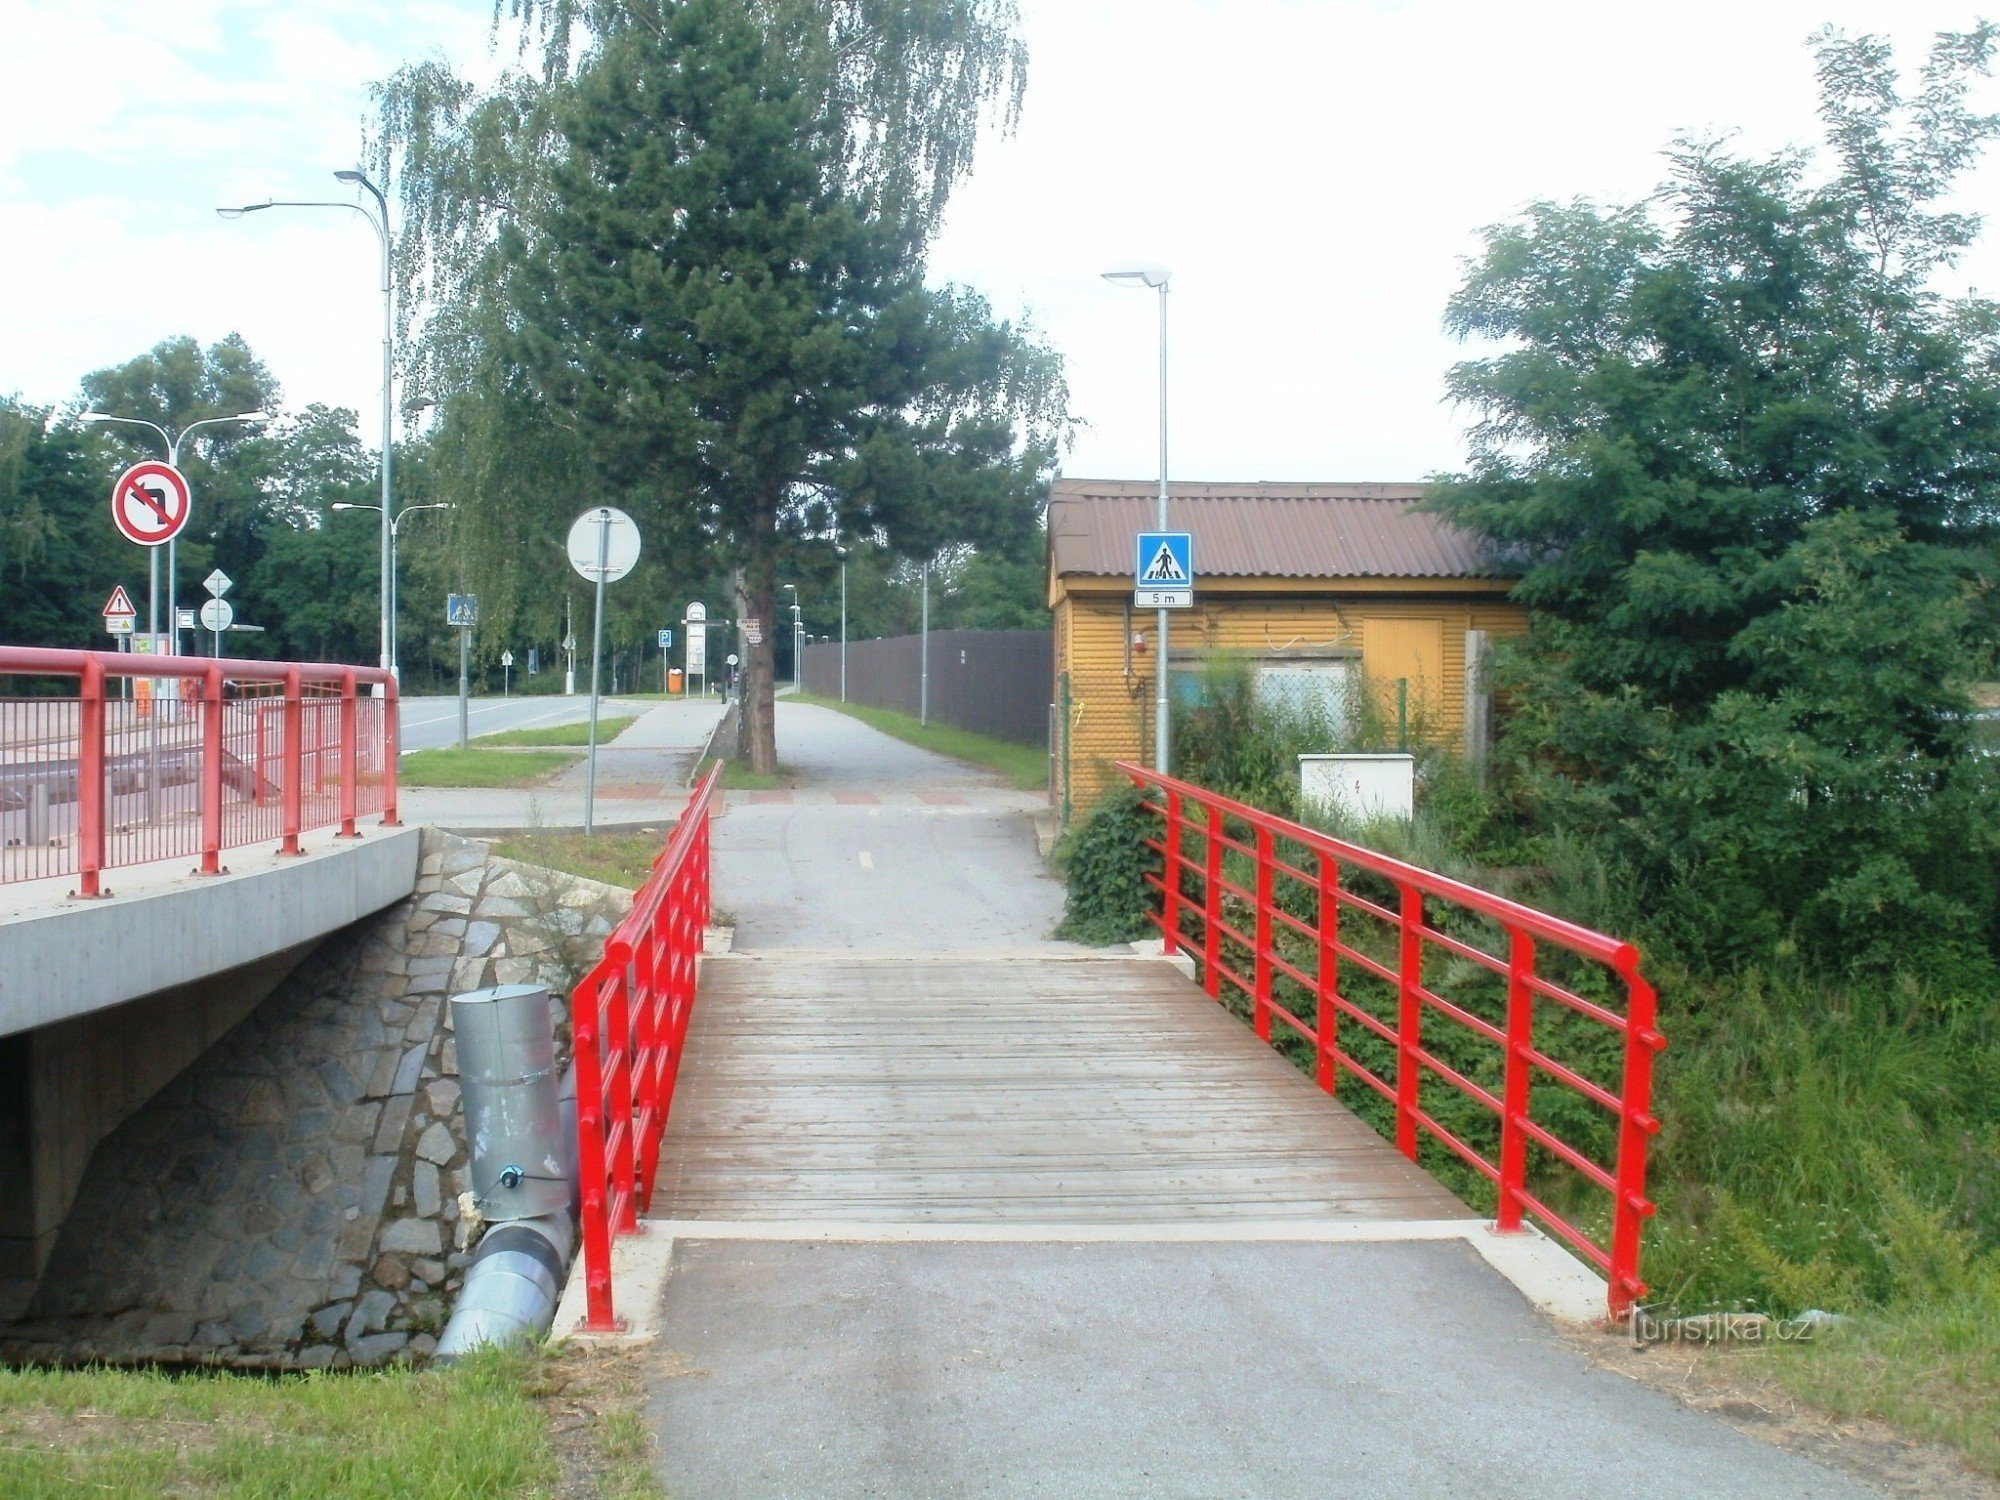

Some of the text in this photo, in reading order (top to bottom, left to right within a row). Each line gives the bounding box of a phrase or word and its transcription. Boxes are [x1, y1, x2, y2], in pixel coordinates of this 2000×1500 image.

[1152, 593, 1175, 603] 5 m
[661, 632, 669, 643] P
